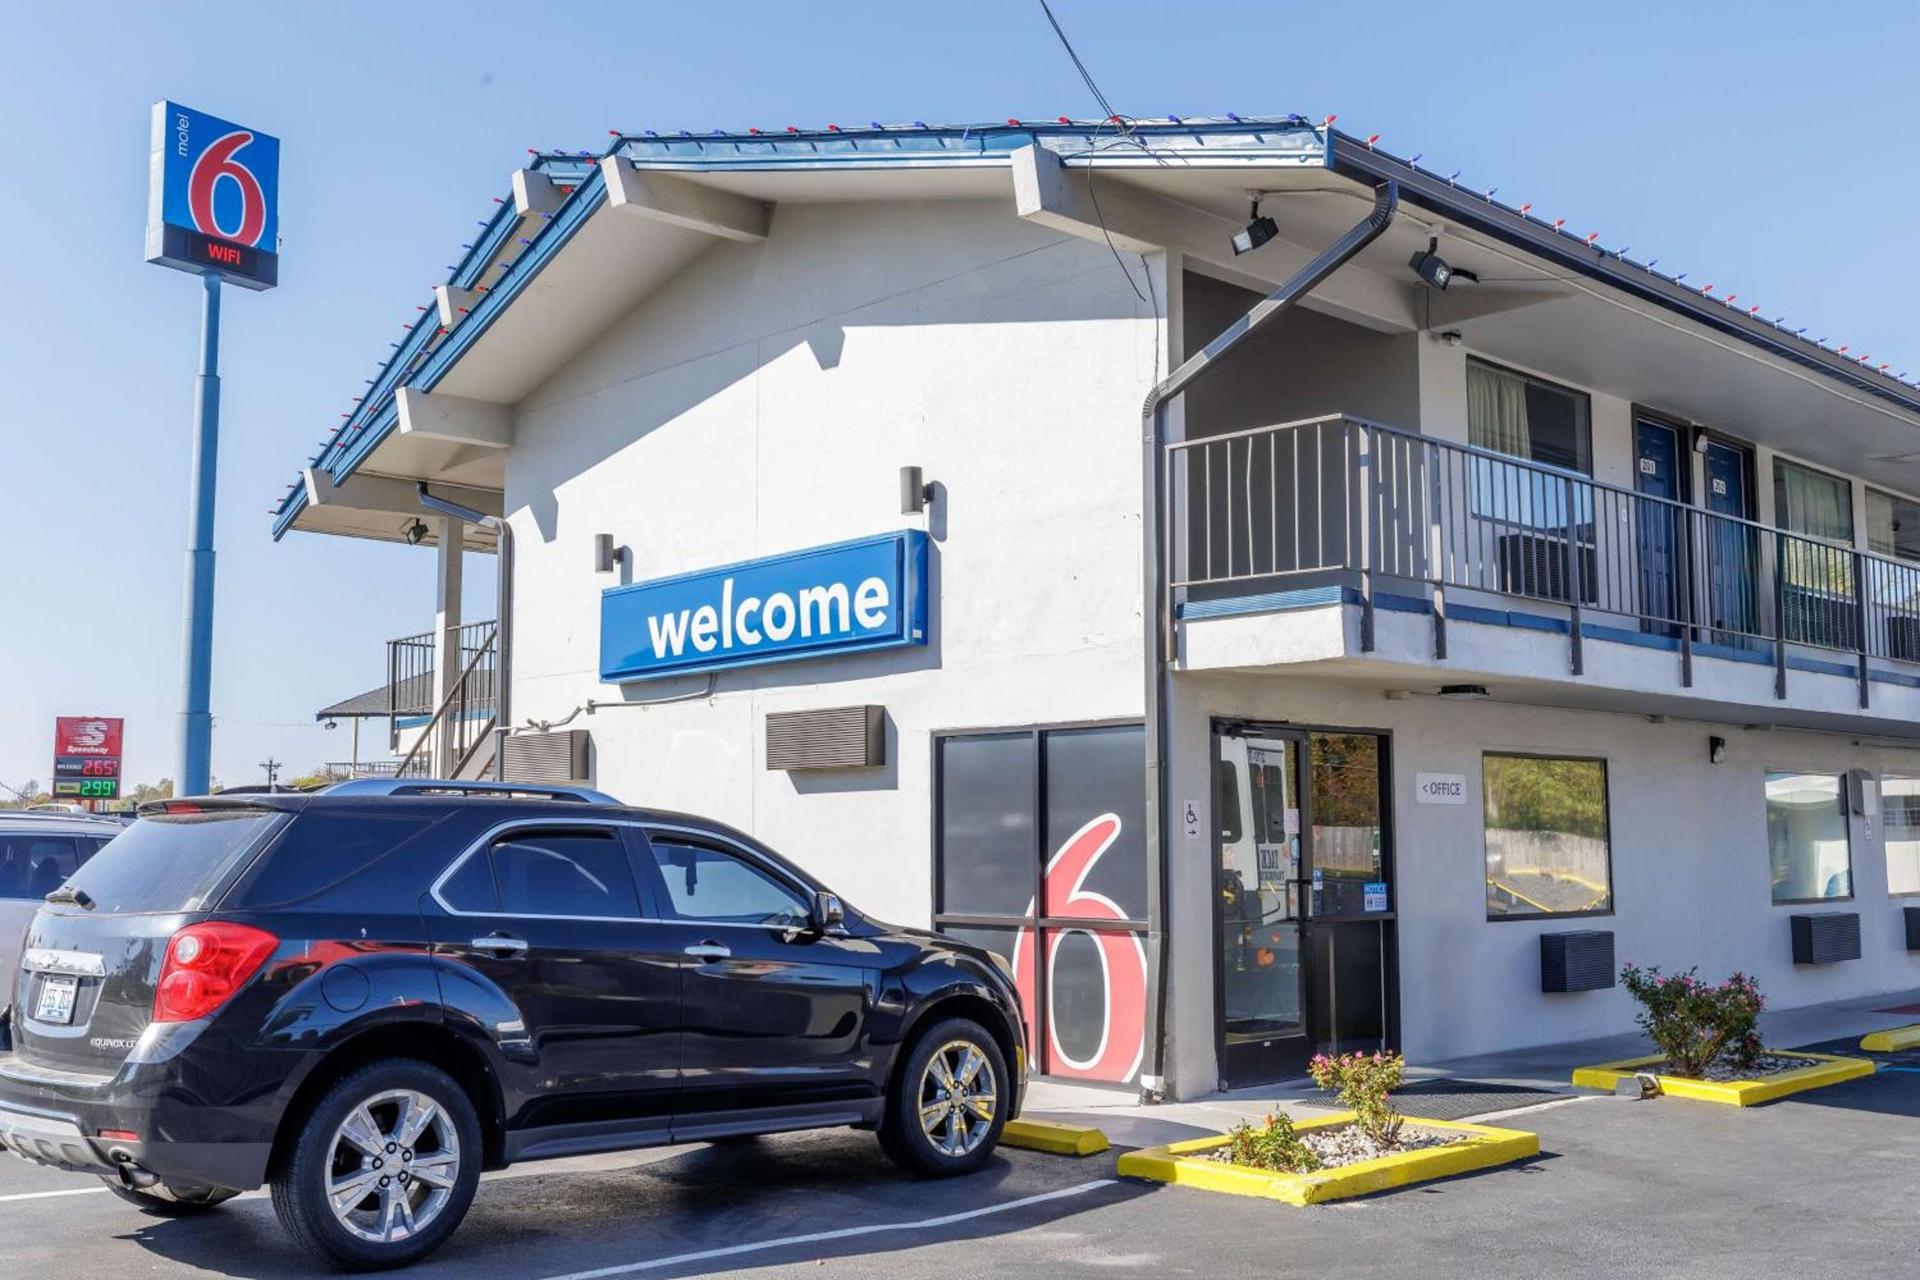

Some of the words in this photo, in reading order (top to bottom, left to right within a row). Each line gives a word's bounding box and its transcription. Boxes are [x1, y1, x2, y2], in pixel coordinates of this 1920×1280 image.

[177, 114, 189, 156] motel
[188, 130, 267, 247] 6
[208, 243, 240, 265] WIFI
[648, 576, 889, 659] welcome
[67, 745, 108, 754] Speedway
[1430, 782, 1461, 796] OFFICE
[1012, 812, 1147, 1082] 6
